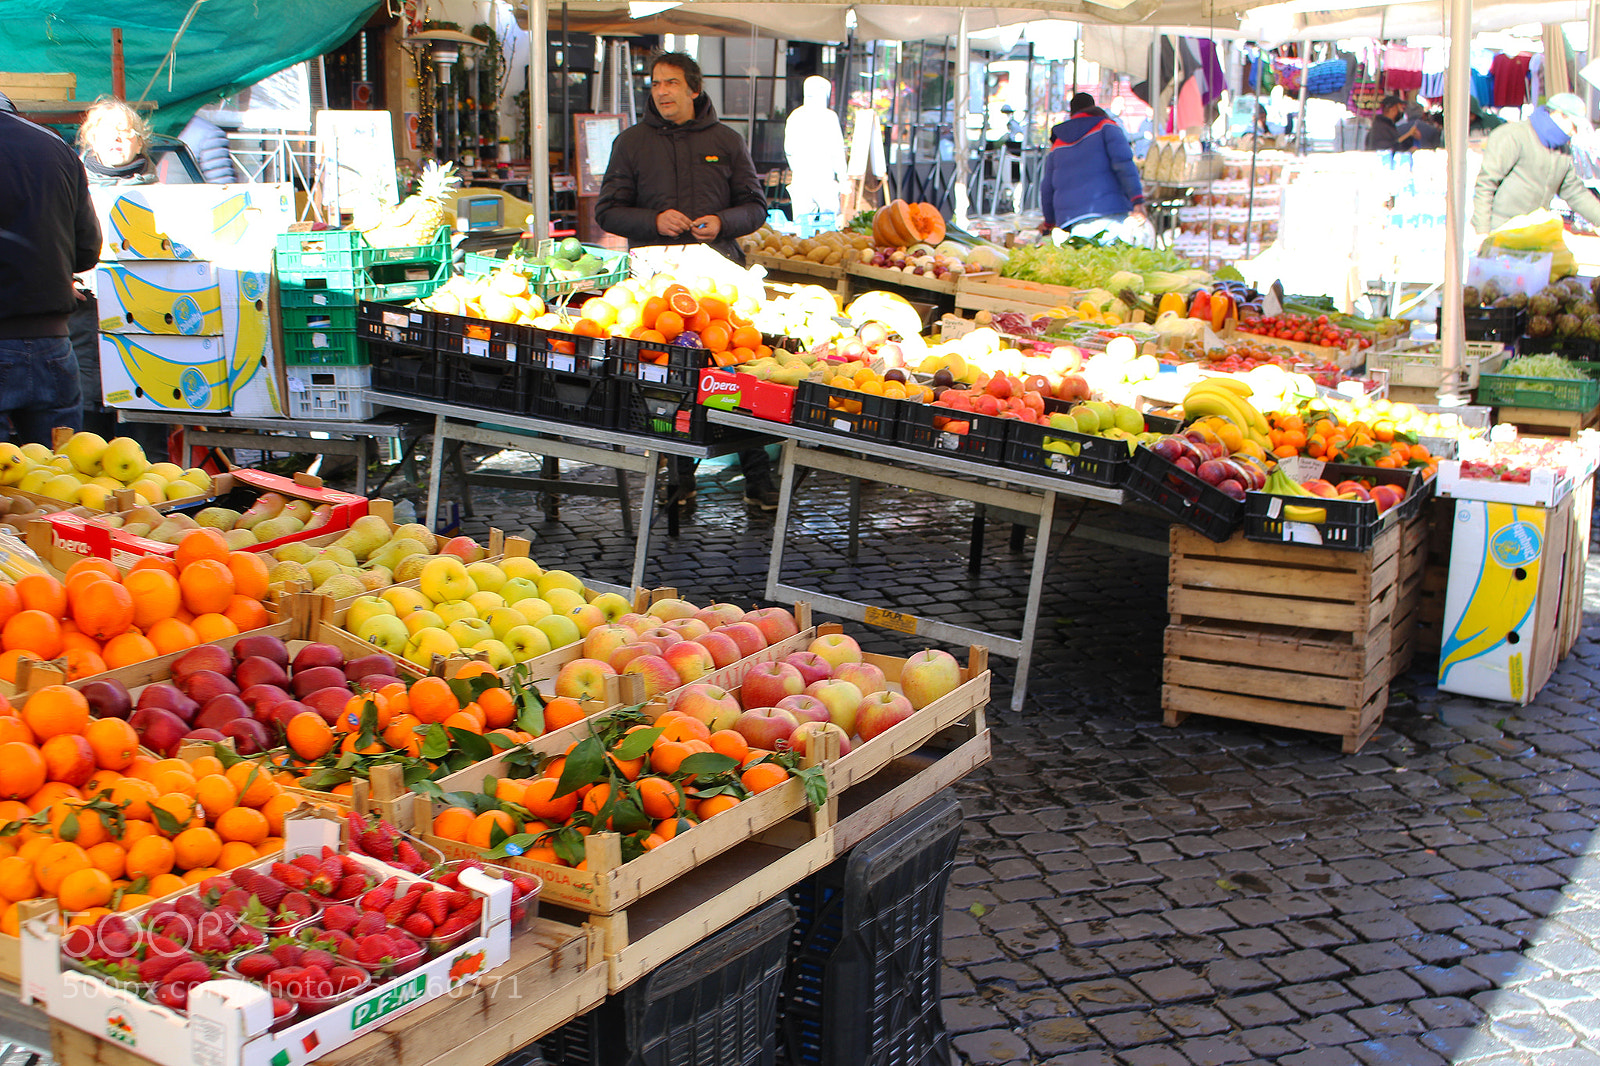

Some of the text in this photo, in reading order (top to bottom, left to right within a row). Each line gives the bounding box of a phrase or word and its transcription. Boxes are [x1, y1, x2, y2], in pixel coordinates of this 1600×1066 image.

[700, 375, 737, 393] Opera
[1512, 523, 1537, 562] Chiquita
[354, 981, 425, 1026] P.F.M.
